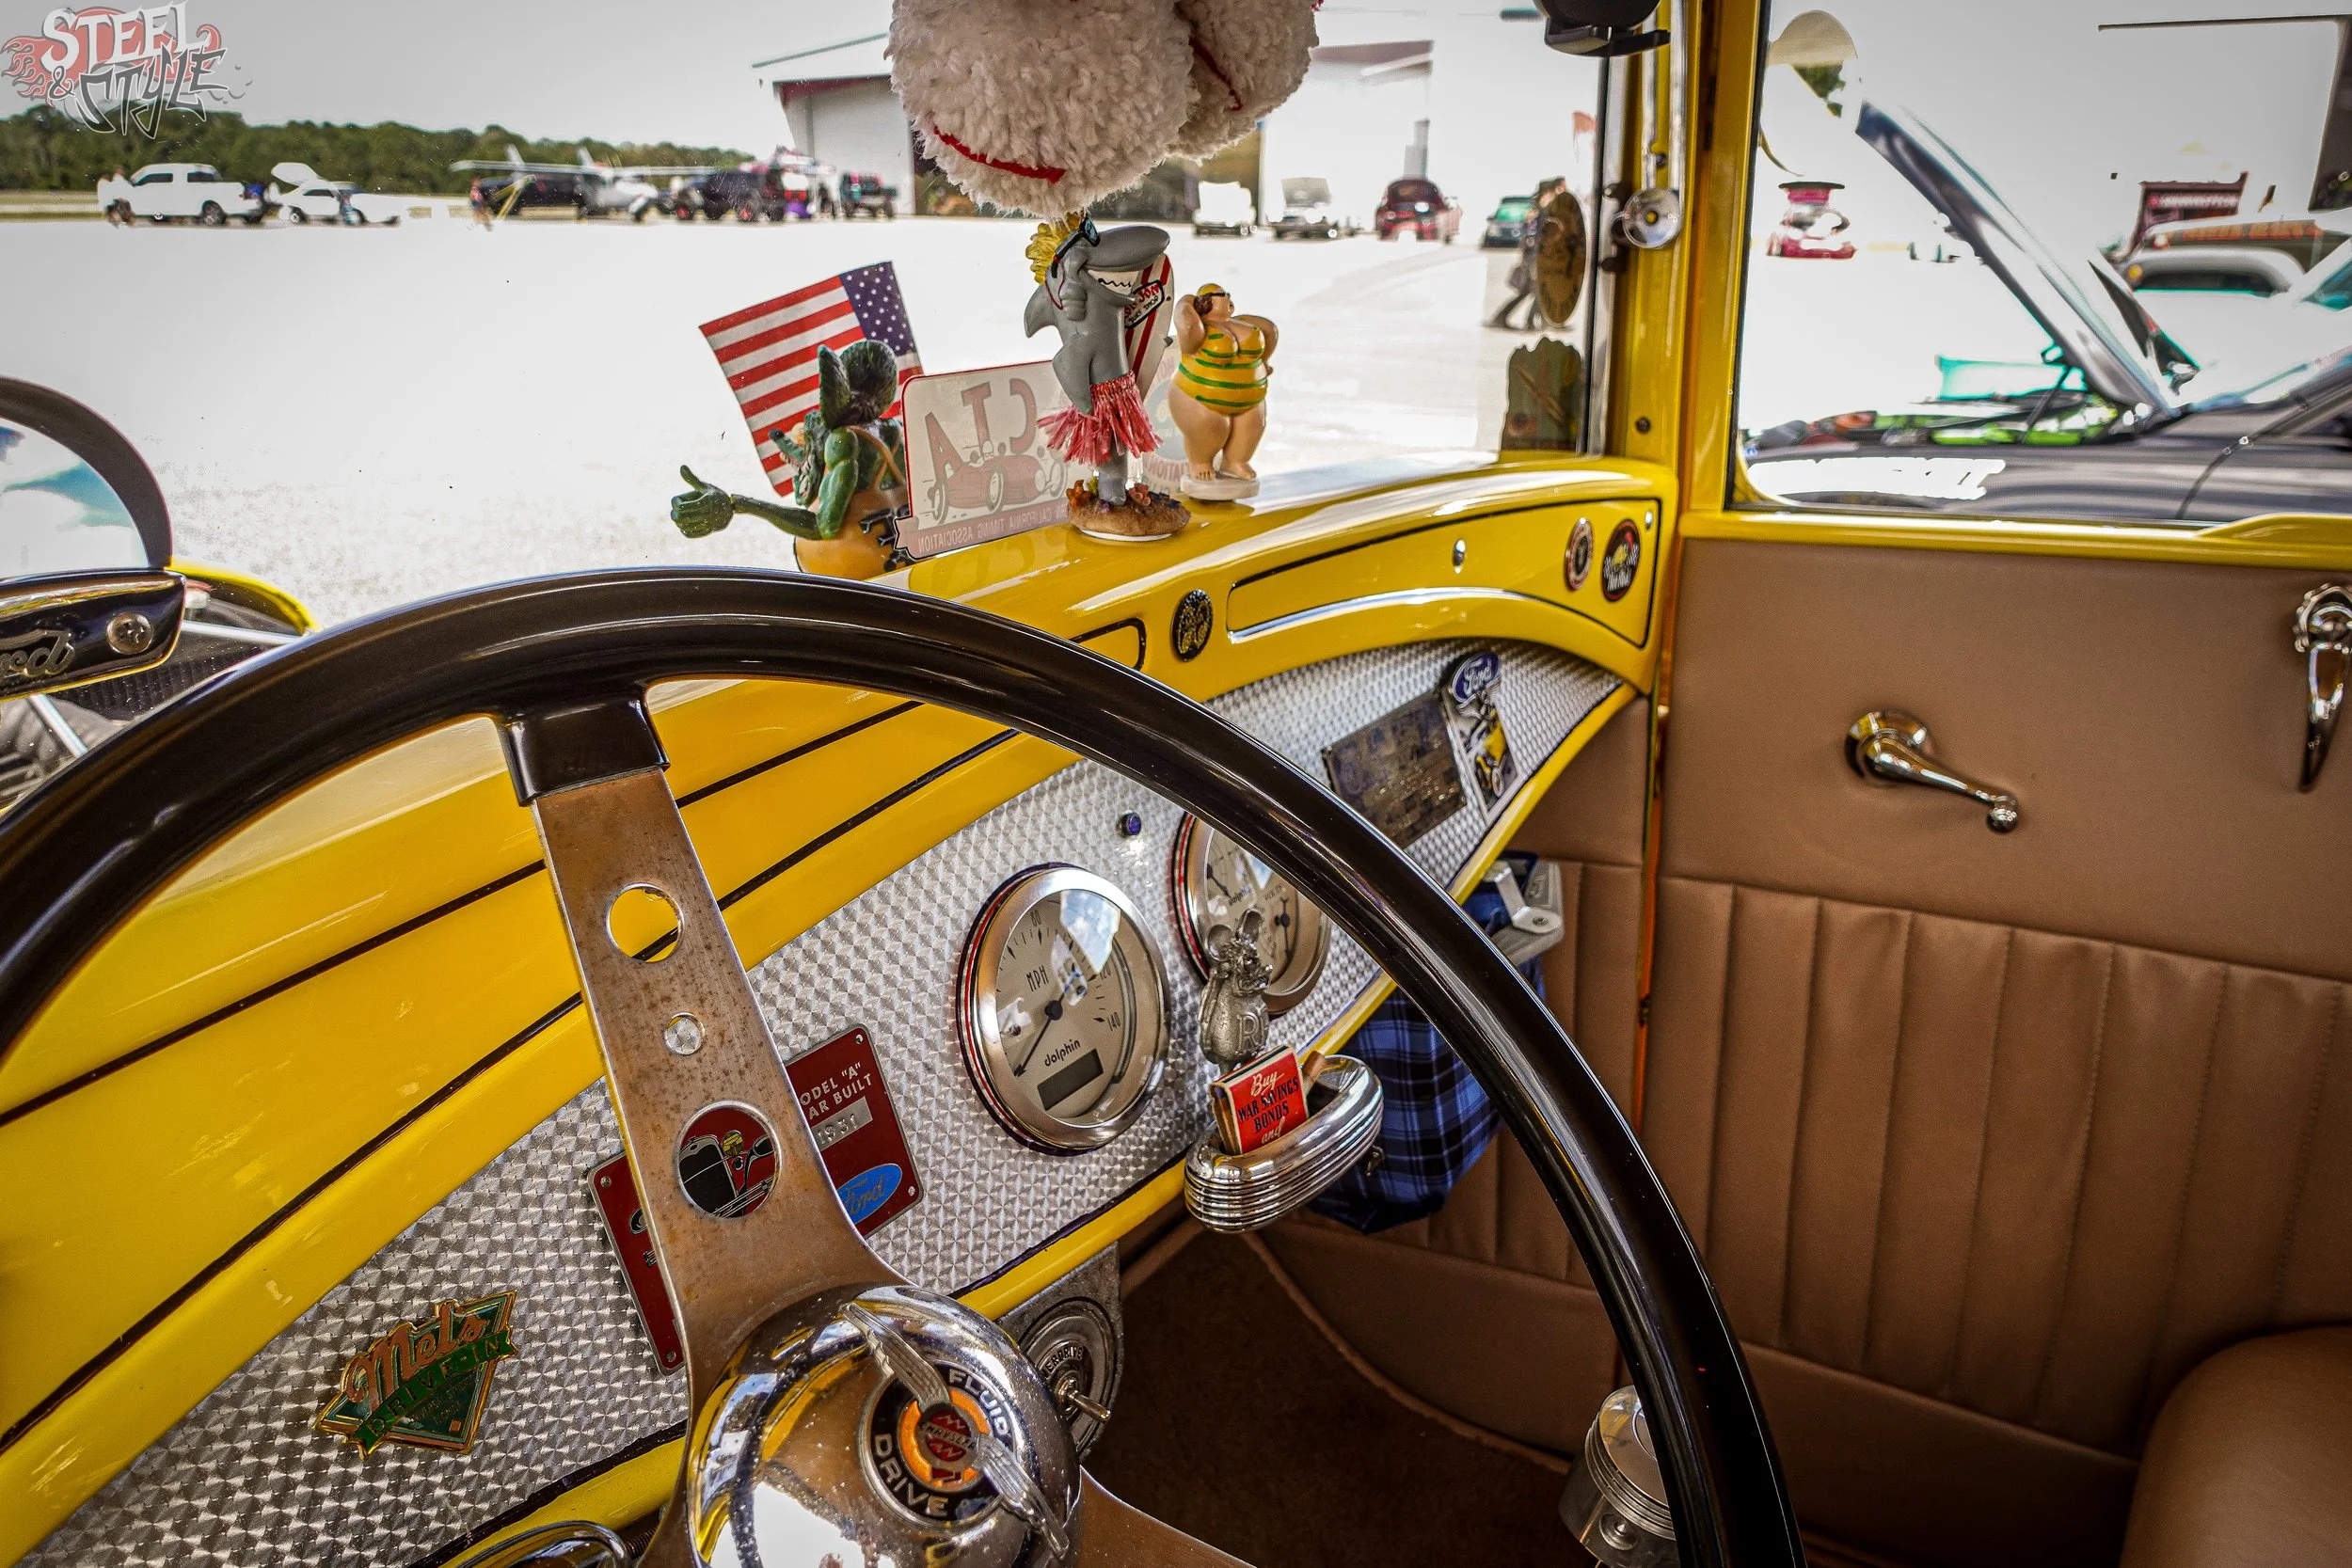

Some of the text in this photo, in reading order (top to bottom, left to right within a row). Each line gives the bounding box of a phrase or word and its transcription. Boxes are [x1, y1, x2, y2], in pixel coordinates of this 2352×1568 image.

[1463, 657, 1493, 698] Ford
[1030, 910, 1042, 927] 80
[1025, 965, 1049, 992] MPH
[1106, 1015, 1121, 1032] 140
[1044, 1038, 1081, 1067] dolphin
[799, 1062, 862, 1106] ODEL "A"
[808, 1073, 872, 1120] AR BUILT
[1237, 1076, 1300, 1123] WAR SAVINGS
[1250, 1070, 1285, 1097] Buy
[1253, 1101, 1290, 1133] BONDS
[1261, 1116, 1285, 1144] and
[368, 1338, 503, 1435] DRIVE-IN
[948, 1368, 1012, 1435] FLUID
[874, 1433, 950, 1518] DRIVE
